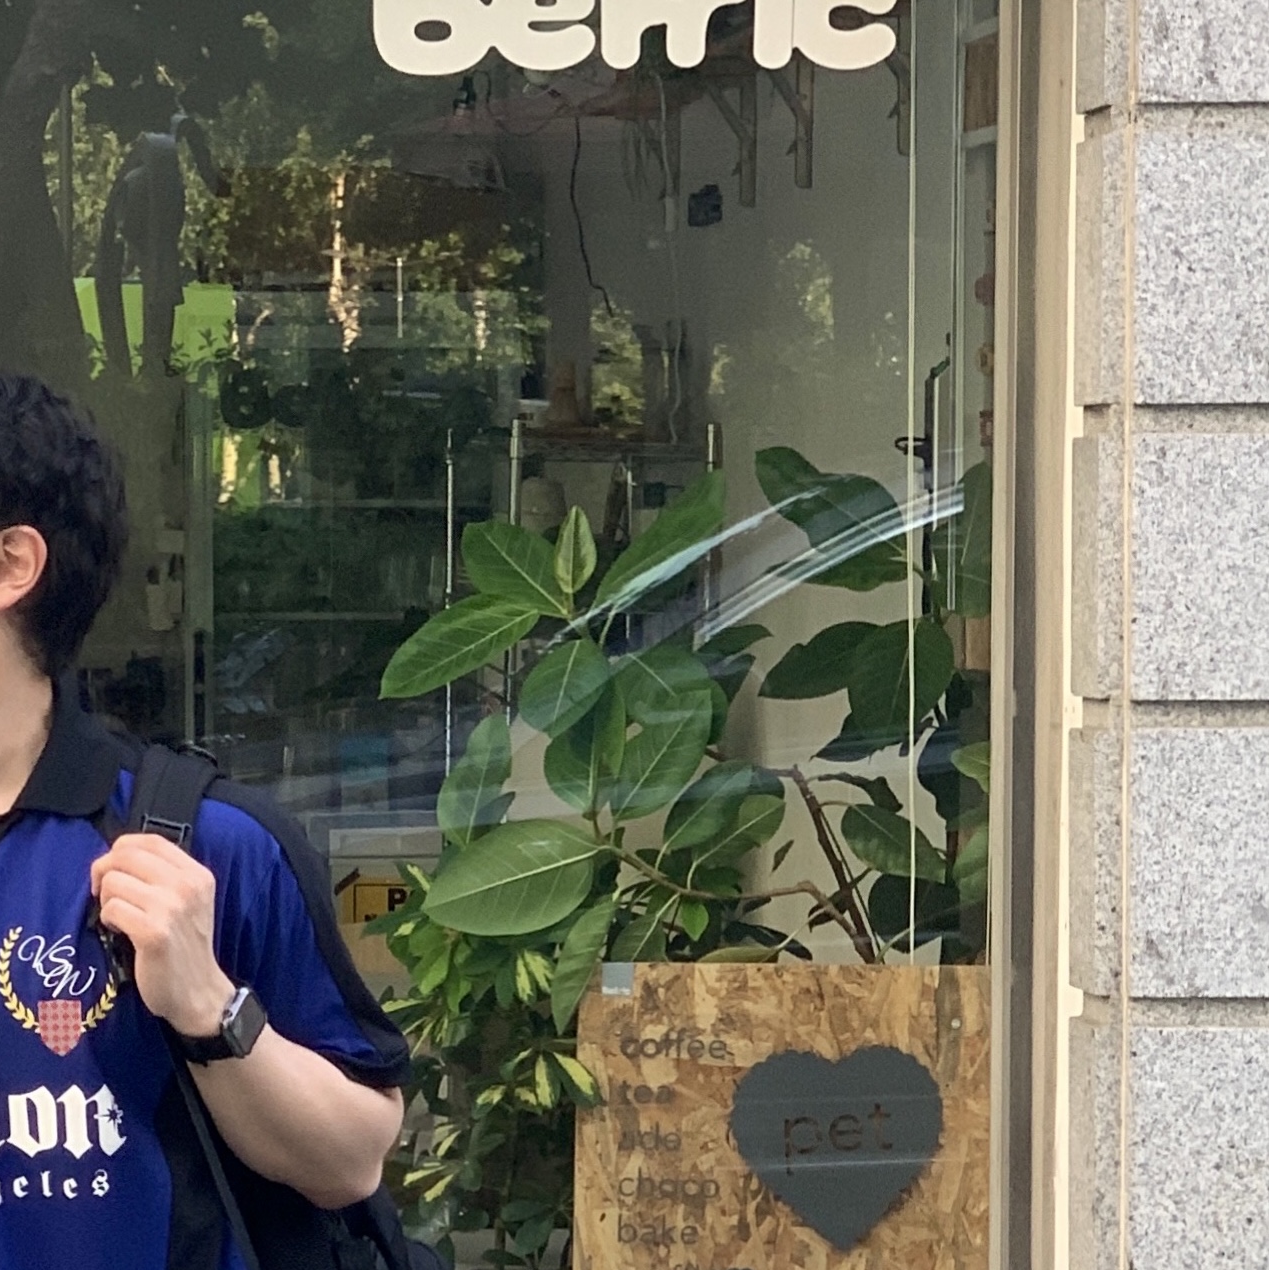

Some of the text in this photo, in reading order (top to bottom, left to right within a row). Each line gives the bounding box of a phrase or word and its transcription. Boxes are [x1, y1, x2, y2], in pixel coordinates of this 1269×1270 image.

[620, 1028, 727, 1059] coffee
[618, 1080, 673, 1104] tea
[783, 1102, 893, 1176] pet
[617, 1213, 699, 1245] bake
